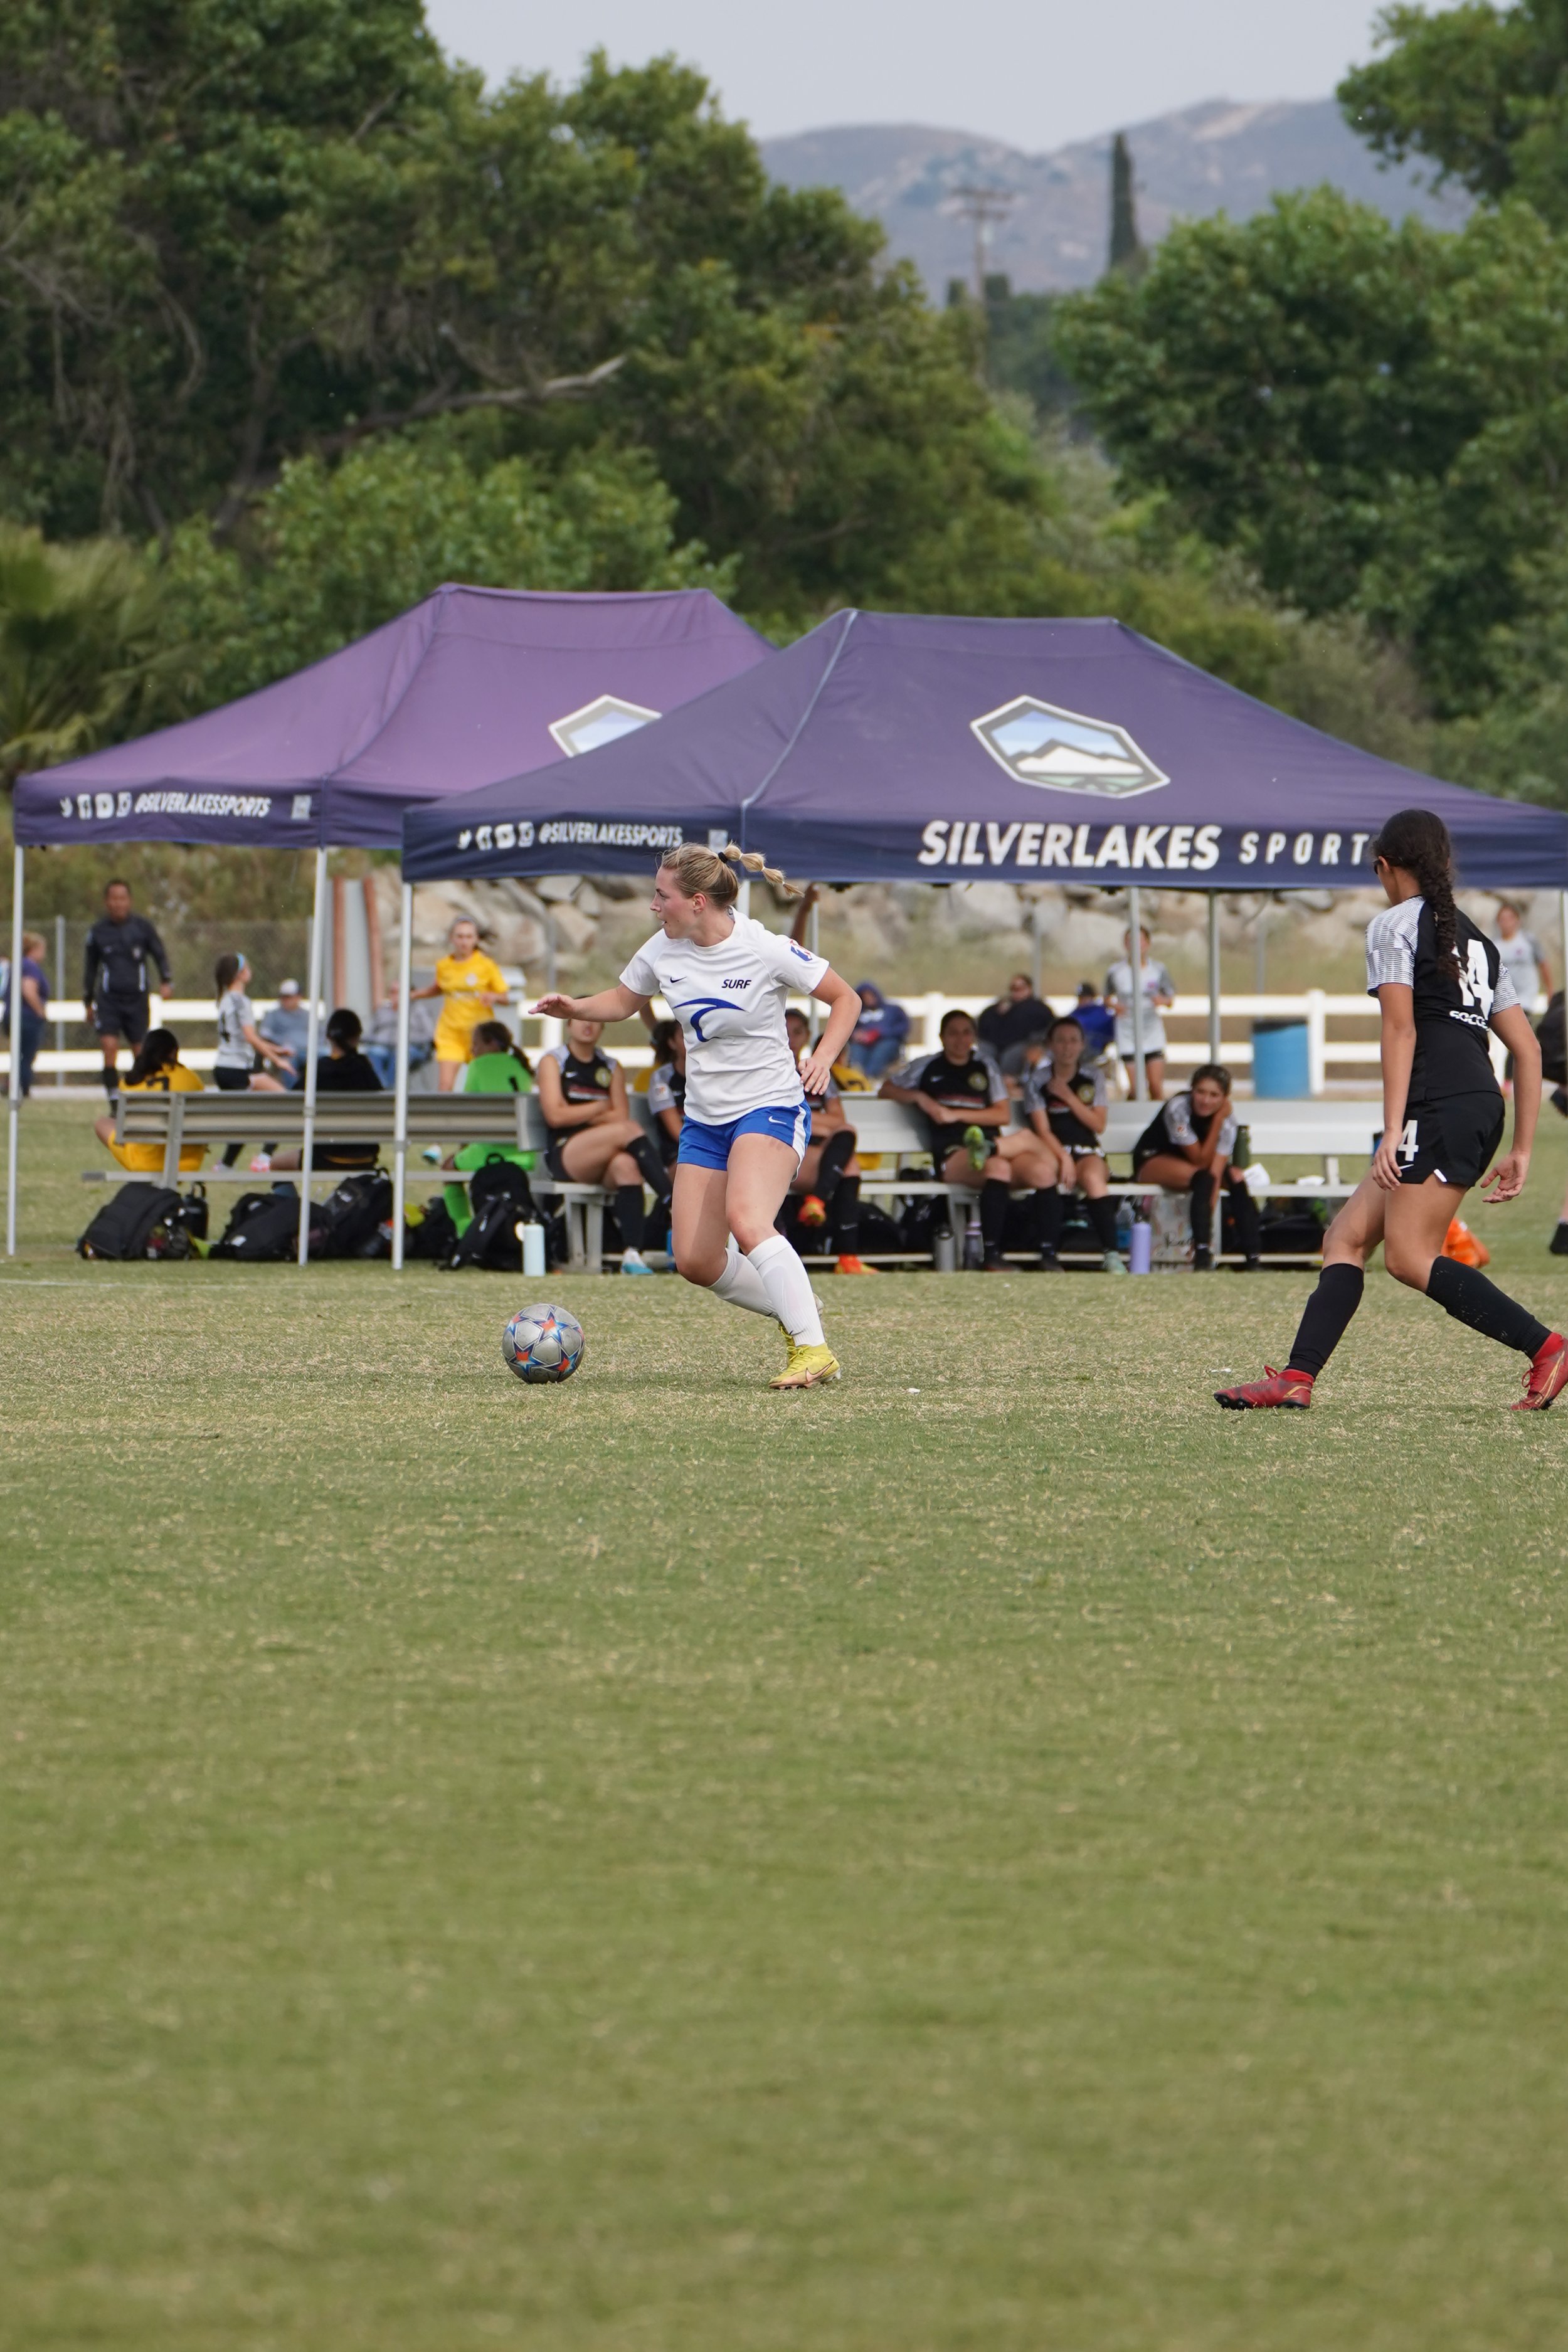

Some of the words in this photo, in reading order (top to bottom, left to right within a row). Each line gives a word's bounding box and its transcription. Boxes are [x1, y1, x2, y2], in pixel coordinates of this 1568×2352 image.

[538, 821, 683, 847] @SILVERLAKESSPORTS
[917, 820, 1222, 871] SILVERLAKES
[1238, 831, 1370, 866] SPORT
[721, 978, 752, 989] SURF
[1449, 1010, 1489, 1031] SOCC
